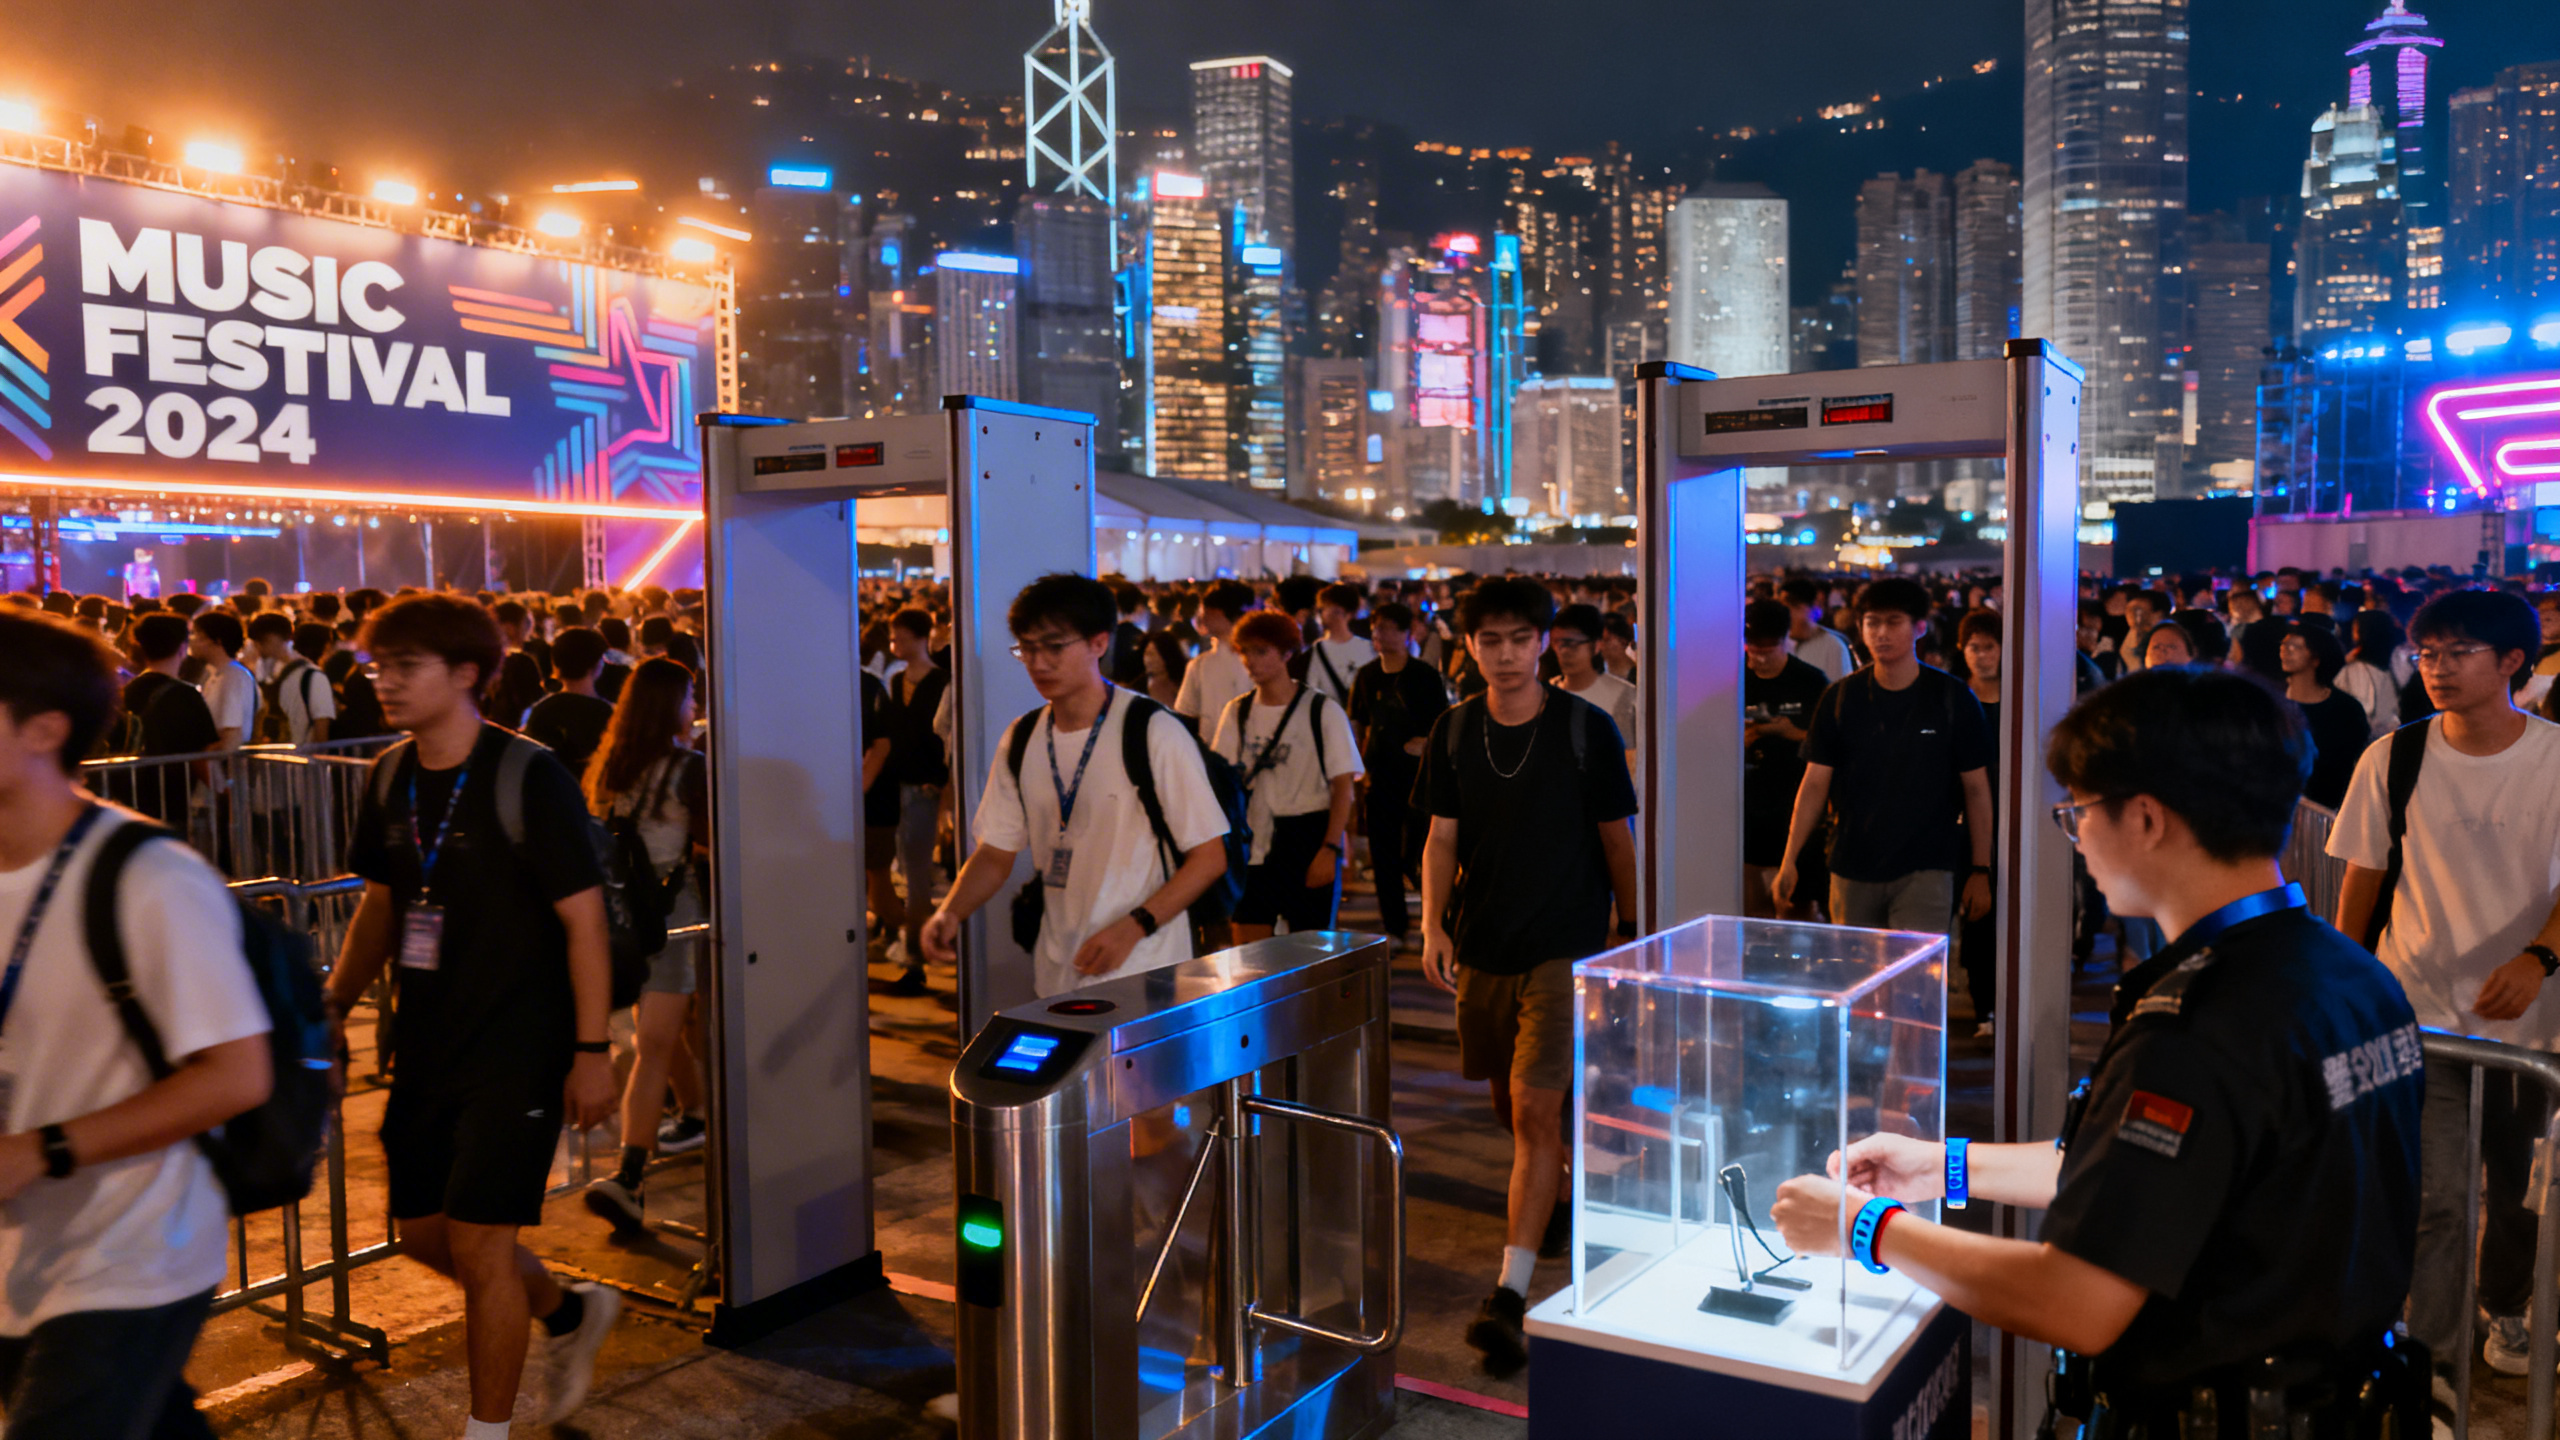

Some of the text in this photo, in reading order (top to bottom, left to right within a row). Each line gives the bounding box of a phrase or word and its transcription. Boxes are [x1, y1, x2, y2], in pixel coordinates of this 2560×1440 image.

[79, 217, 405, 332] MUSIC
[83, 303, 511, 416] FESTIVAL
[85, 386, 317, 464] 2024
